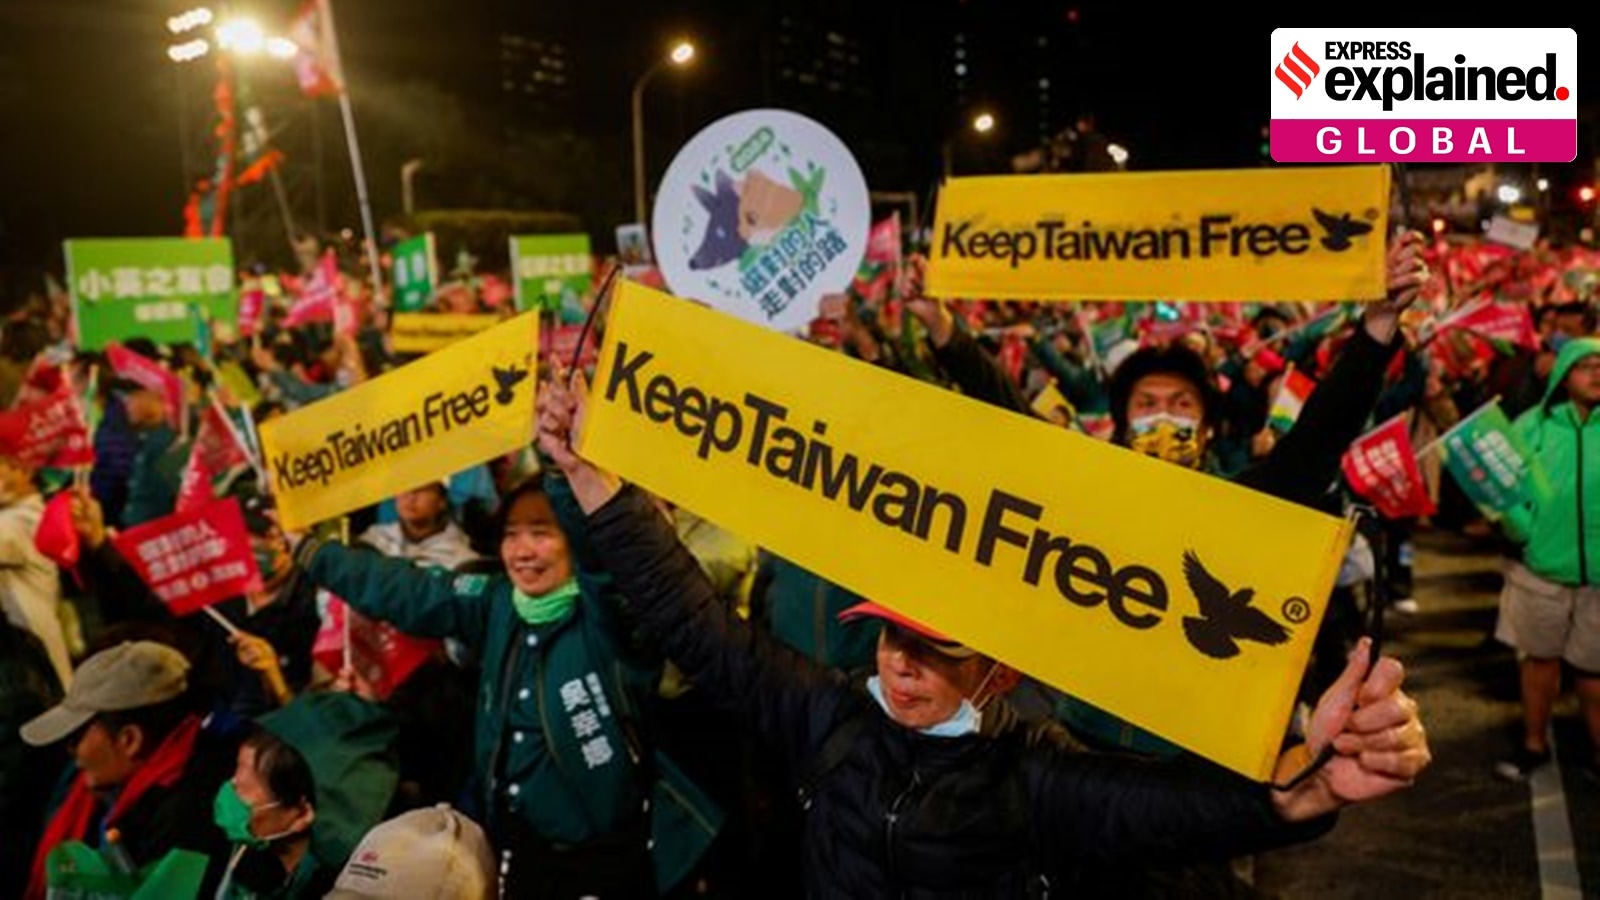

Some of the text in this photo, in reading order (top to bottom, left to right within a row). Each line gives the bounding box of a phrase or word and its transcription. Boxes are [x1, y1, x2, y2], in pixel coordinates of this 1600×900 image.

[1200, 216, 1311, 257] Free
[423, 384, 490, 437] Free
[975, 489, 1170, 630] Free
